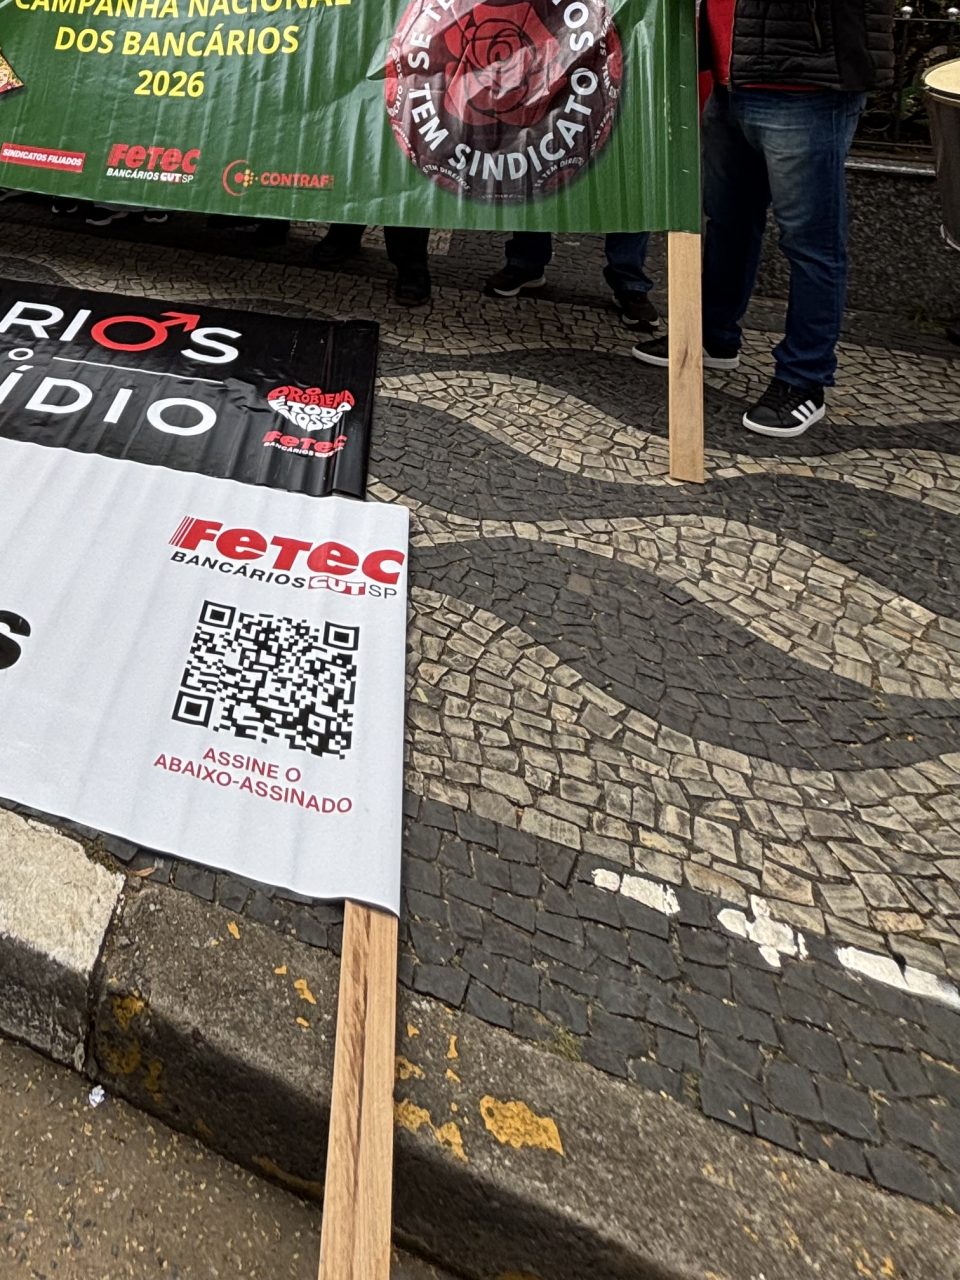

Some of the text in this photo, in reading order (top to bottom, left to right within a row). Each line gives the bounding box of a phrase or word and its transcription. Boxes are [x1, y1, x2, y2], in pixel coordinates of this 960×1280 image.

[54, 23, 300, 57] DOS BANCÁRIOS
[407, 31, 432, 70] SE
[134, 70, 205, 98] 2026
[407, 82, 449, 151] TEM
[447, 67, 599, 181] SINDICATO
[2, 148, 83, 167] SINDICATOS FILIADOS
[106, 167, 159, 181] BANCÁRIOS
[182, 174, 194, 184] SP
[261, 172, 330, 188] CONTRAF
[7, 347, 34, 361] O
[267, 385, 355, 408] PROBLEMA
[277, 409, 343, 432] NOSSO
[170, 550, 398, 600] BANCÁRIOS CUT SP
[203, 747, 302, 783] ASSINE O
[153, 753, 353, 814] ABAIXO-ASSINADO
